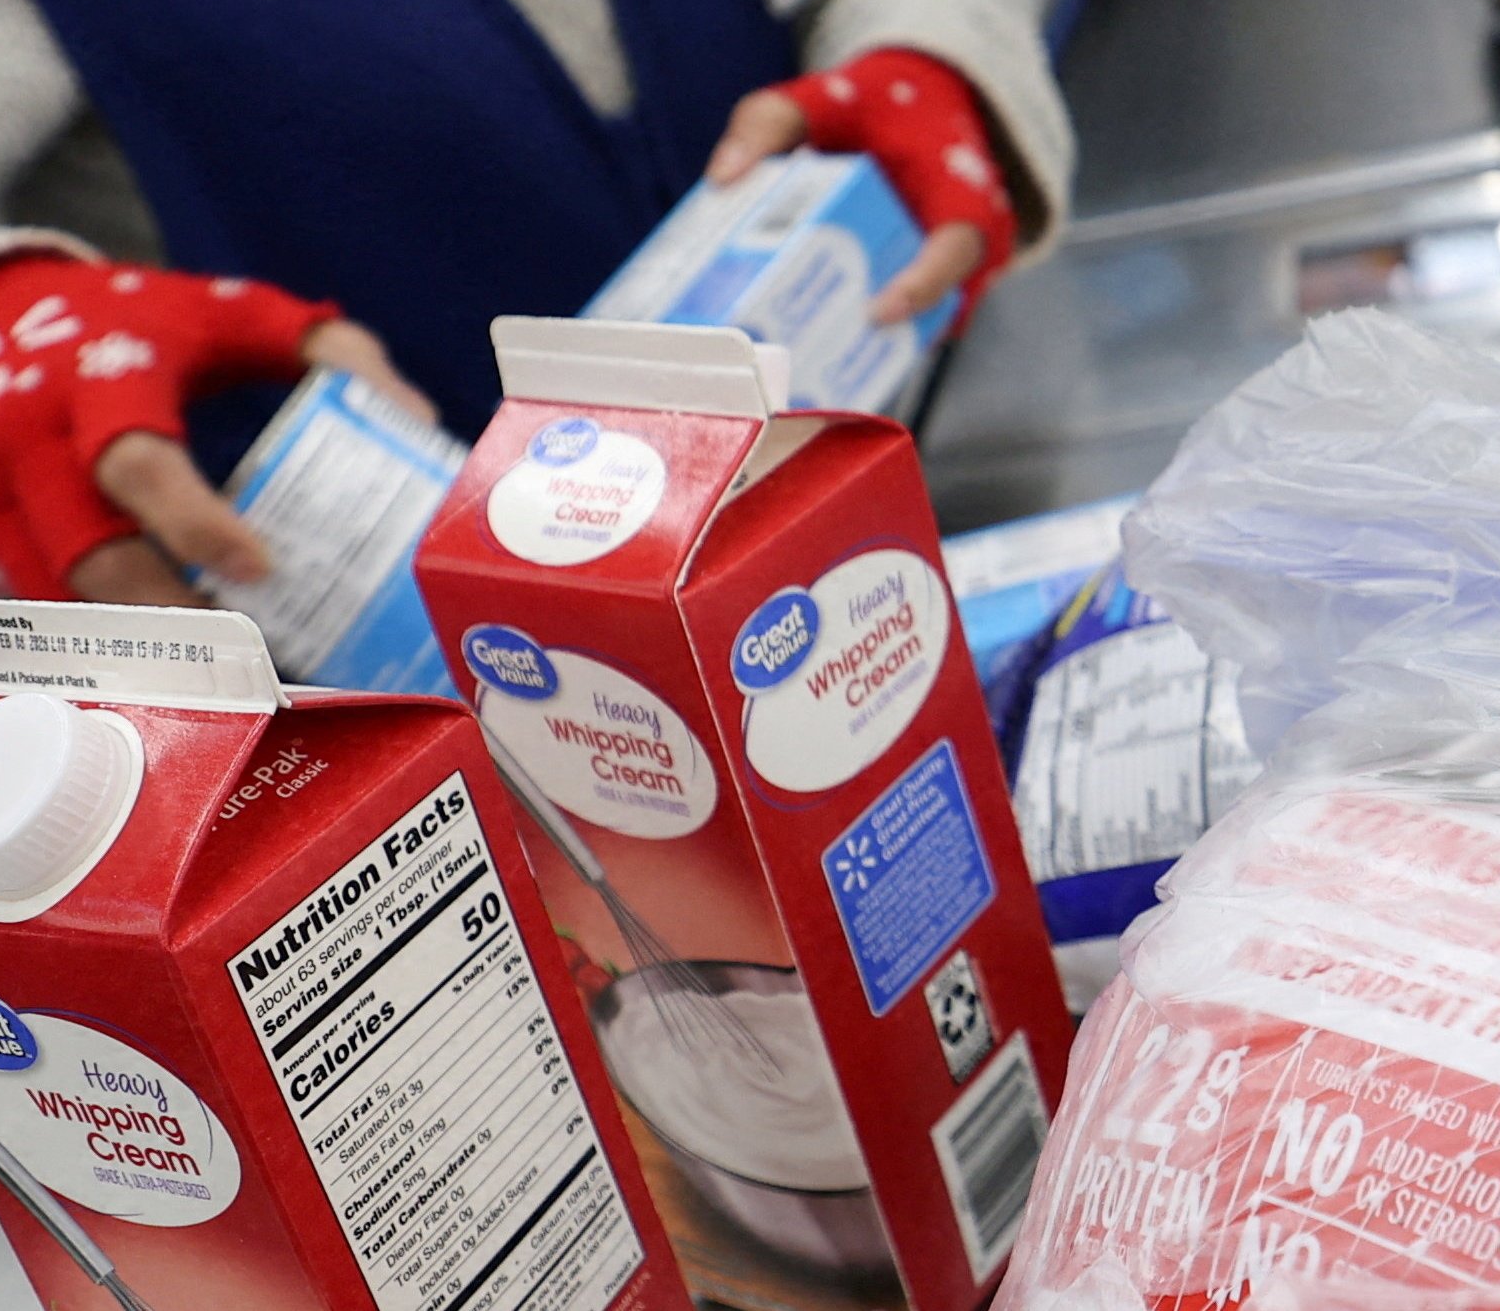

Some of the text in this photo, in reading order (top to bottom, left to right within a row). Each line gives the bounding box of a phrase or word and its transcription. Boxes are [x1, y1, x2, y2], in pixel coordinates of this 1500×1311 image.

[545, 477, 635, 506] Whipping
[555, 501, 621, 527] Cream
[18, 616, 34, 632] By
[849, 570, 906, 627] Heavy
[471, 638, 539, 673] Great
[739, 601, 807, 666] Great
[760, 627, 809, 674] Value
[806, 601, 914, 701] Whipping
[10, 671, 17, 684] &
[18, 671, 55, 687] Packaged
[56, 673, 65, 686] at
[65, 675, 85, 688] Plant
[494, 663, 547, 689] Value
[845, 633, 923, 707] Cream
[544, 715, 674, 769] Whipping
[593, 691, 662, 739] Heavy
[211, 747, 309, 832] ure-Pak
[275, 758, 330, 799] Classic
[591, 755, 684, 797] Cream
[236, 791, 464, 992] Nutrition Facts
[256, 841, 451, 1018] about 63 servings per container
[263, 840, 480, 1037] Serving size 1 Tbsp. (15mL)
[291, 892, 500, 1101] Calories 50
[463, 963, 484, 985] Daily
[283, 991, 375, 1078] Amount per serving
[536, 1037, 553, 1055] 0%
[81, 1059, 168, 1113] Heavy
[544, 1056, 560, 1074] 0%
[552, 1077, 568, 1094] 0%
[1102, 1024, 1250, 1148] 22g
[1307, 1057, 1392, 1106] TURKEYS
[1389, 1083, 1468, 1131] RAISED
[25, 1088, 186, 1146] Whipping
[315, 1083, 393, 1154] Total Fat 5g
[339, 1080, 424, 1163] Saturated Fat 3g
[86, 1131, 202, 1176] Cream
[345, 1118, 446, 1220] Cholesterol 15mg
[348, 1119, 414, 1183] Trans Fat 0g
[1264, 1096, 1364, 1198] NO
[1367, 1135, 1458, 1194] ADDED
[354, 1167, 426, 1240] Sodium 5mg
[362, 1129, 491, 1259] Total Carbohydrate 0g
[1067, 1144, 1216, 1248] PROTEIN
[386, 1186, 465, 1268] Dietary Fiber 0g
[395, 1207, 473, 1286] Total Sugars 0g
[419, 1251, 461, 1296] Includes
[462, 1236, 478, 1251] 0g
[477, 1200, 505, 1237] Added
[506, 1167, 537, 1203] Sugars
[529, 1227, 573, 1279] Potassium
[531, 1209, 565, 1249] Calcium
[447, 1278, 461, 1294] 0g
